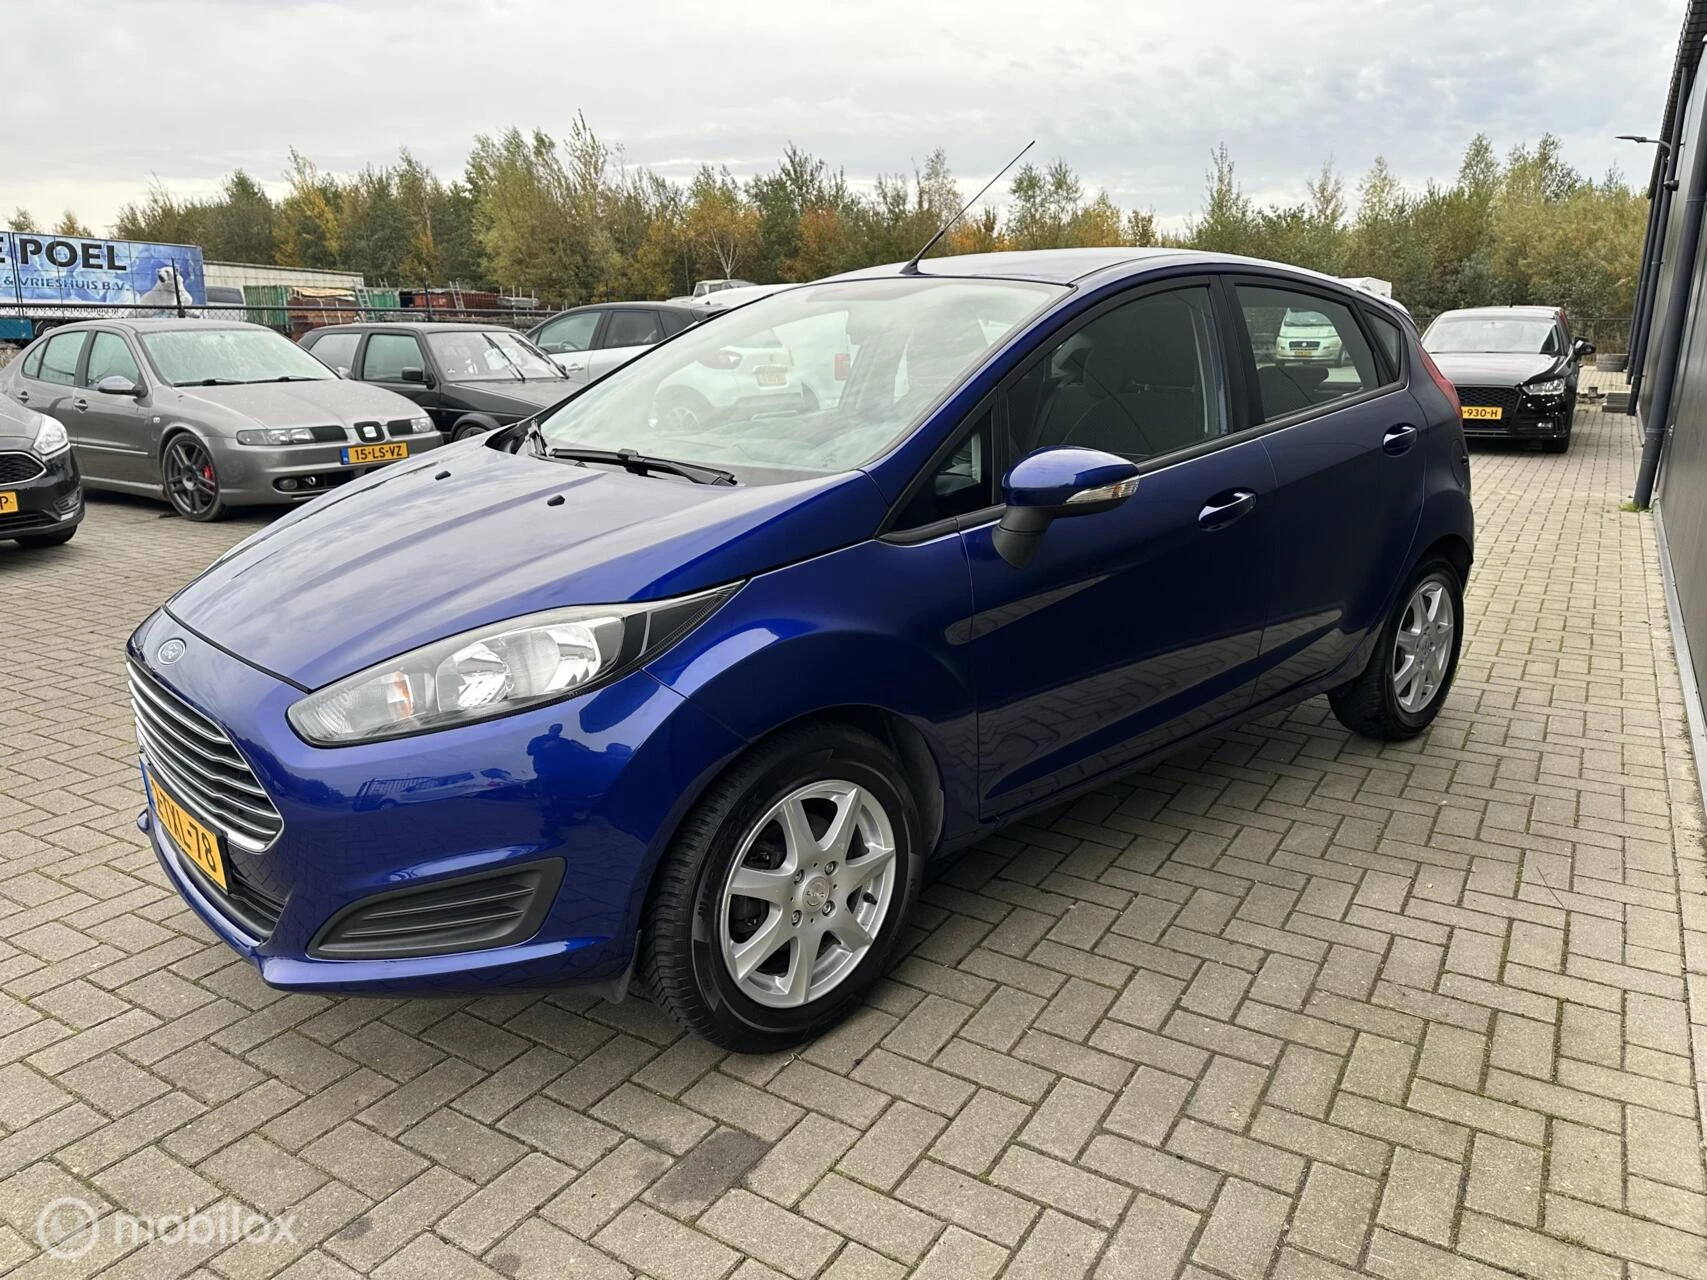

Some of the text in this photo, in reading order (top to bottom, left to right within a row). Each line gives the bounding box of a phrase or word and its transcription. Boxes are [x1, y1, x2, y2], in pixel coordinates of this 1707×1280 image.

[19, 238, 127, 270] POEL
[4, 276, 14, 286] &
[20, 277, 98, 290] VRIESHUIS
[355, 445, 403, 461] 15-LS-VZ
